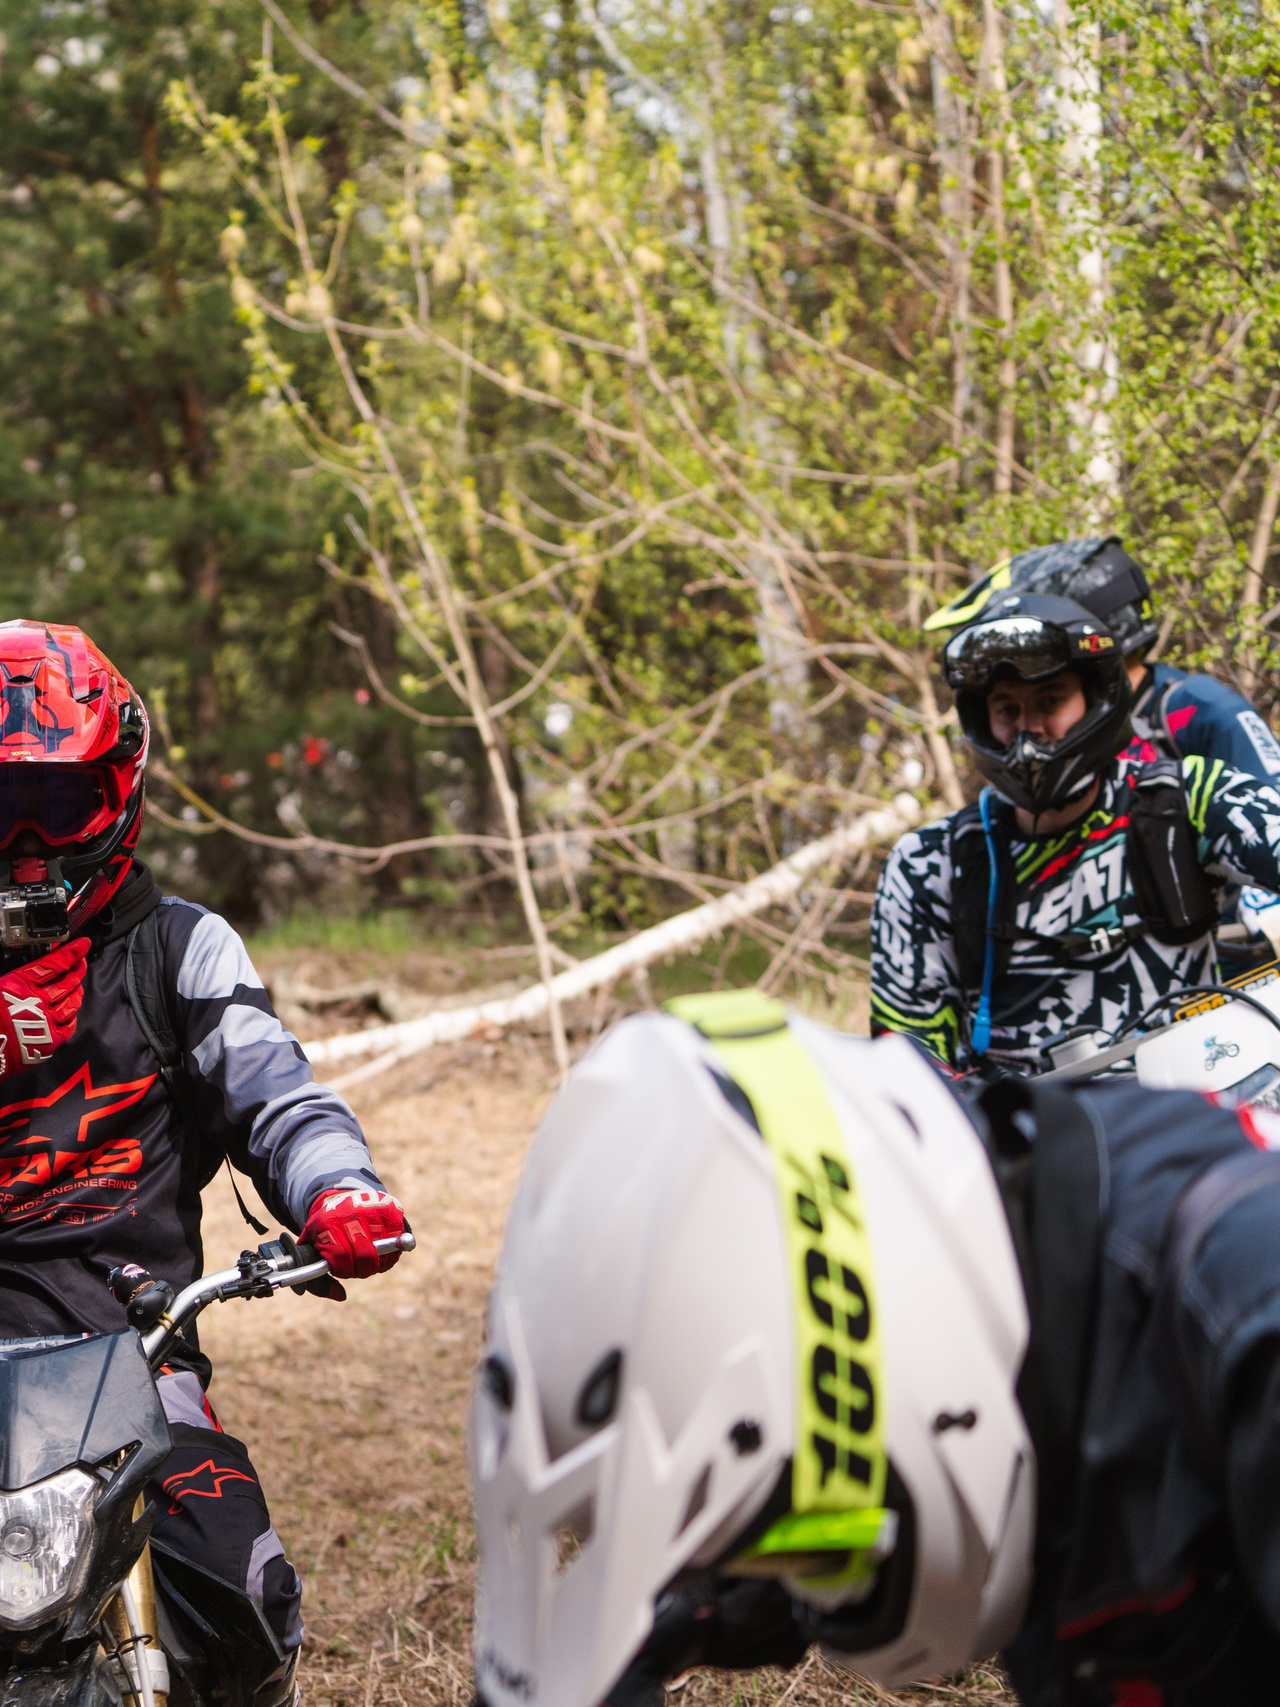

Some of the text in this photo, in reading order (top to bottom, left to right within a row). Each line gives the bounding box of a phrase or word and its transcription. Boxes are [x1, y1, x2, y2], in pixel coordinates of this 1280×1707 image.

[2, 991, 53, 1064] FOX
[0, 1199, 46, 1213] VISION
[43, 1178, 138, 1197] ENGINEERING
[783, 1153, 874, 1489] 100%
